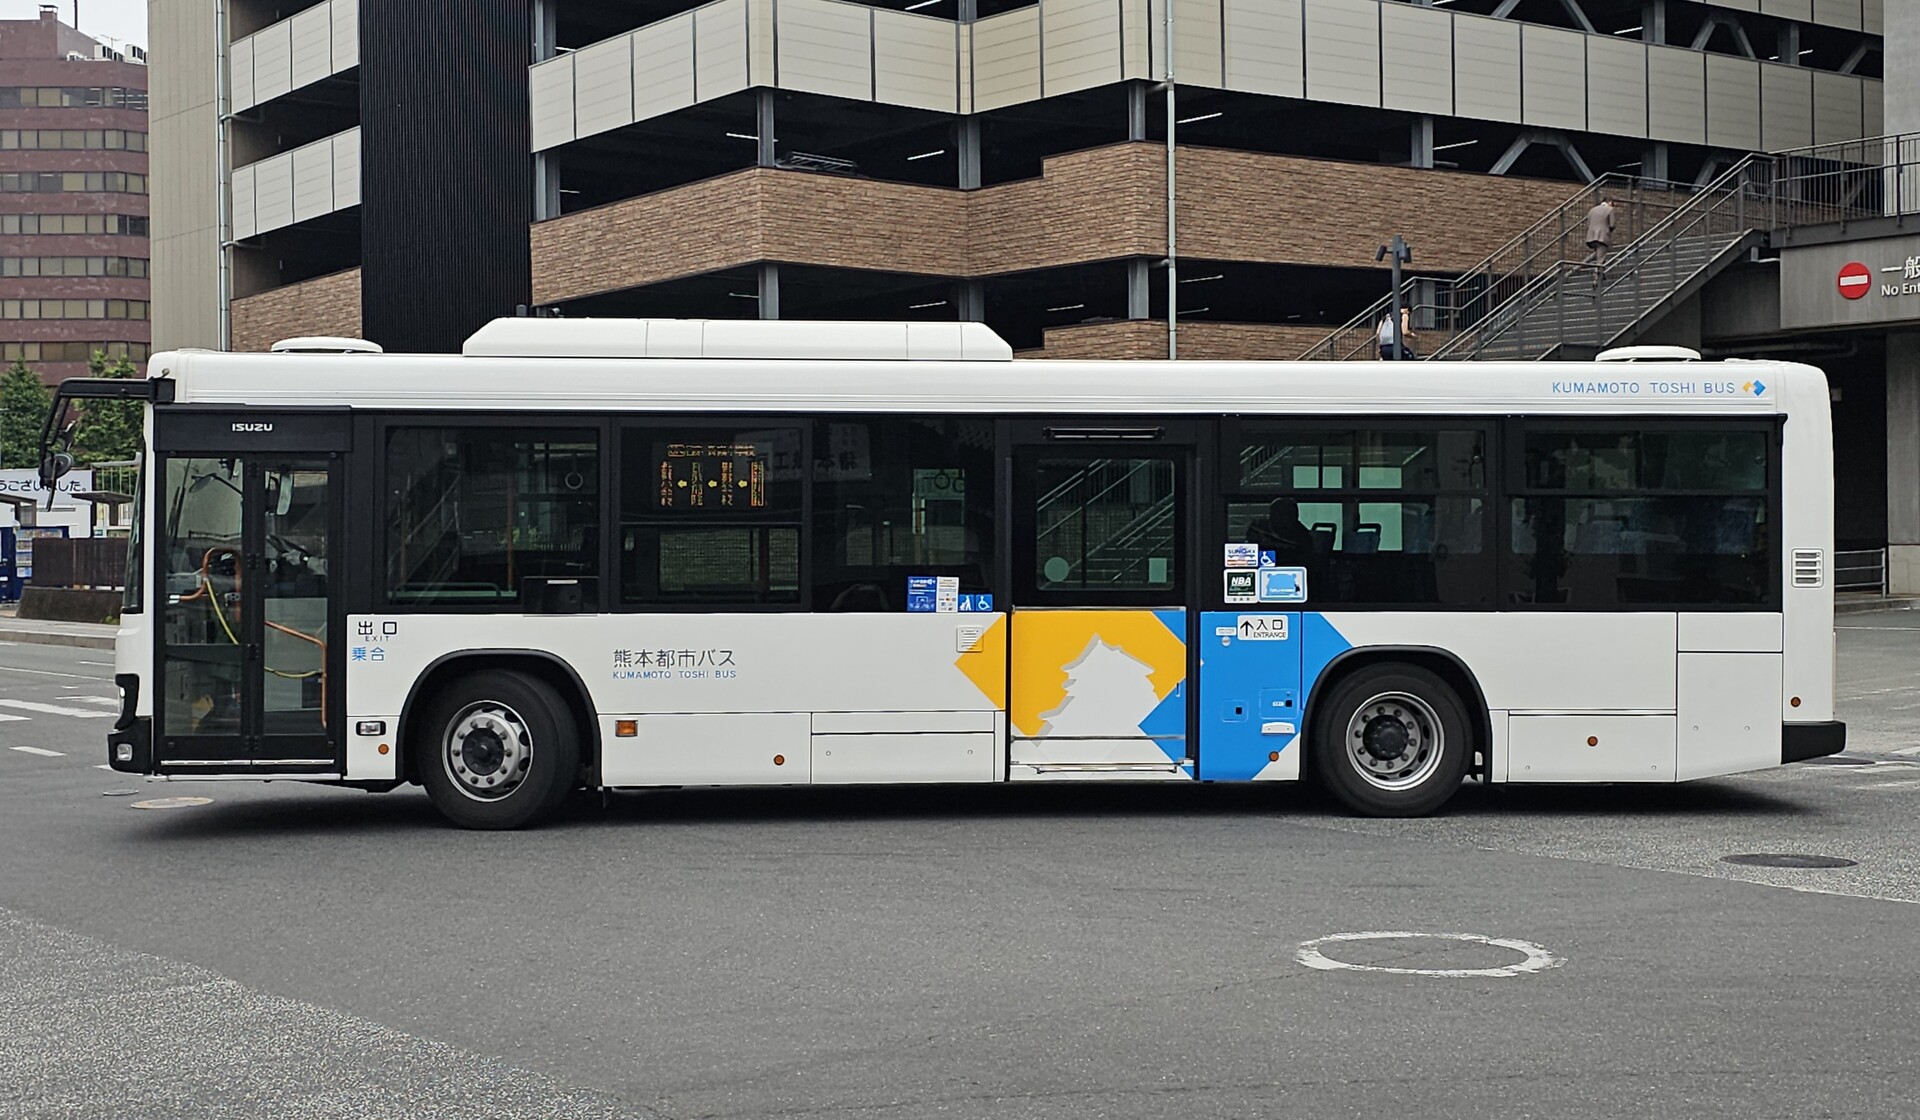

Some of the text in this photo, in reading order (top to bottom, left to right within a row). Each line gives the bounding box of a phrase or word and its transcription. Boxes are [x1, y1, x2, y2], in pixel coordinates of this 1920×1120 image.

[1881, 284, 1899, 296] No
[1552, 382, 1735, 394] KUMAMOTO TOSHI BUS
[231, 423, 273, 432] ISUZU
[0, 480, 87, 493] うございした。
[1231, 576, 1252, 587] NBA
[358, 621, 397, 635] 出口
[1256, 619, 1283, 631] 入口
[352, 646, 385, 661] 乗合
[613, 649, 736, 669] 熊本都市バス
[612, 670, 736, 679] KUMAMOTO TOSHI BUS
